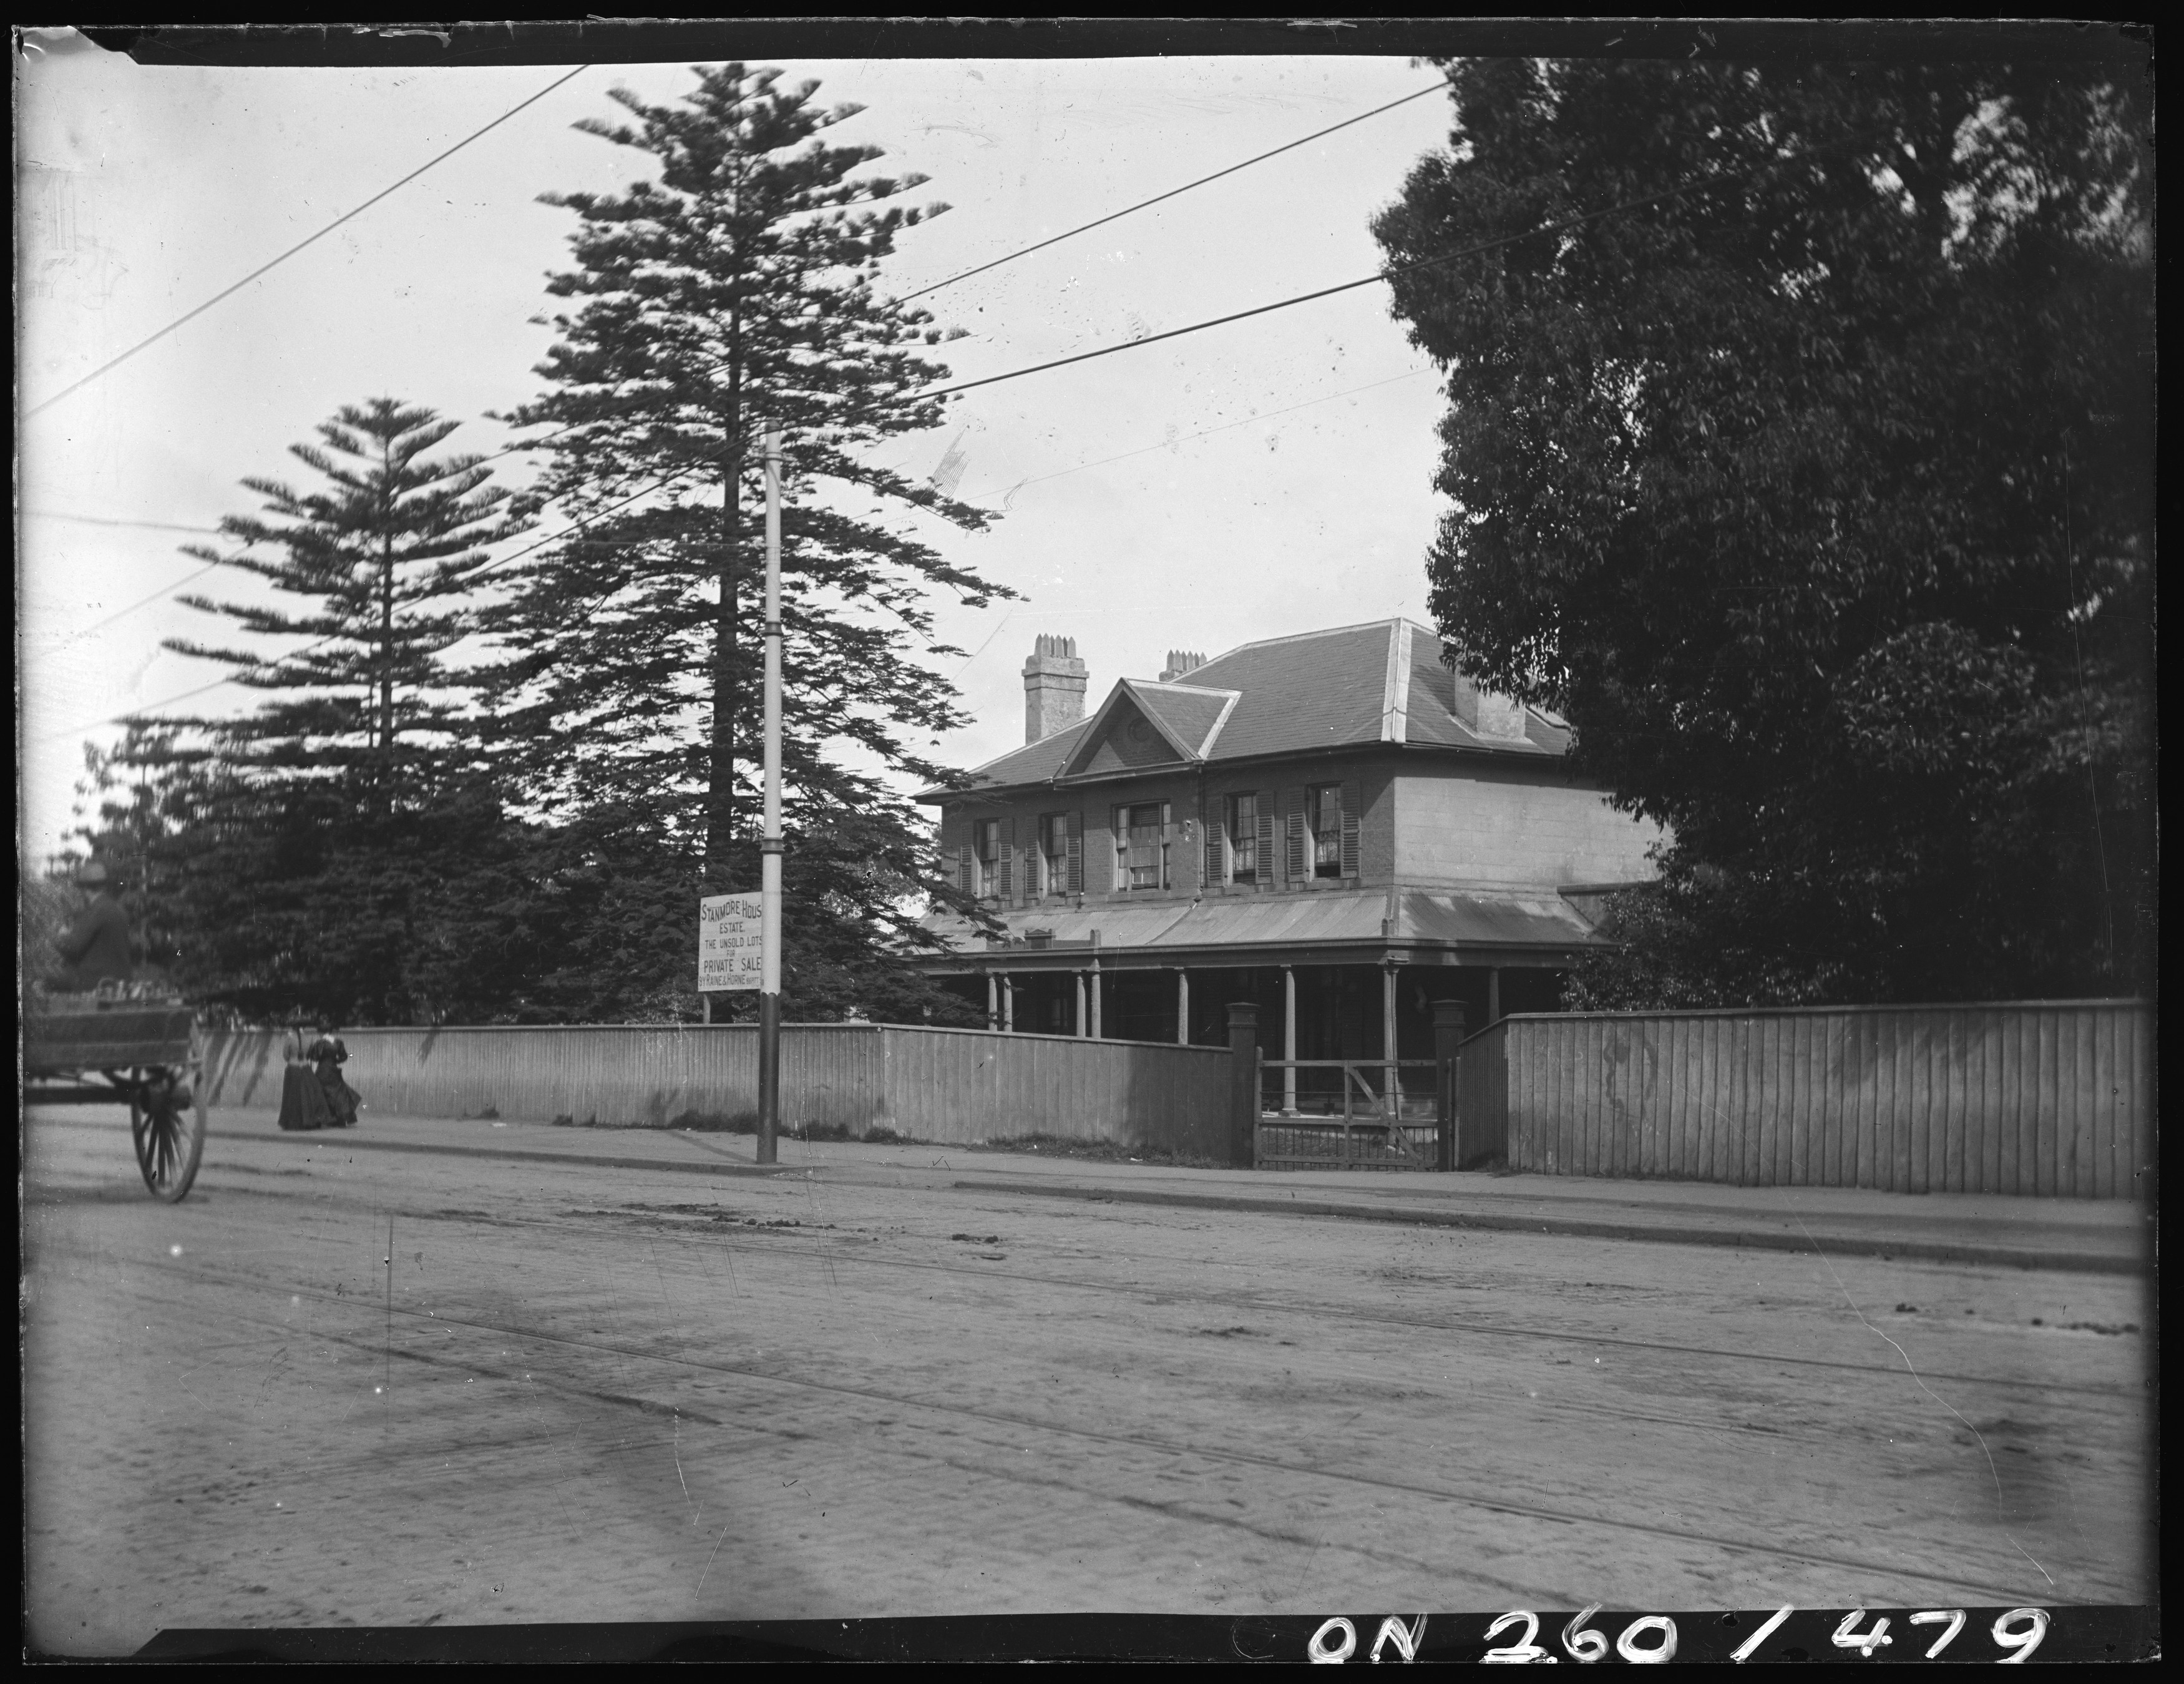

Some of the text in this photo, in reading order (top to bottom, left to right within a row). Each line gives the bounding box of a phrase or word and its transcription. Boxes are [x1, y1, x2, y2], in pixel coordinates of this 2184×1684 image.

[701, 899, 762, 923] STANMORE HOUS
[704, 939, 716, 949] THE
[719, 937, 744, 949] UNSOLD
[704, 957, 761, 973] PRIVATE SALE
[699, 976, 706, 986] BY
[706, 974, 722, 986] RAINE
[723, 976, 726, 986] &
[727, 973, 746, 986] HORNE
